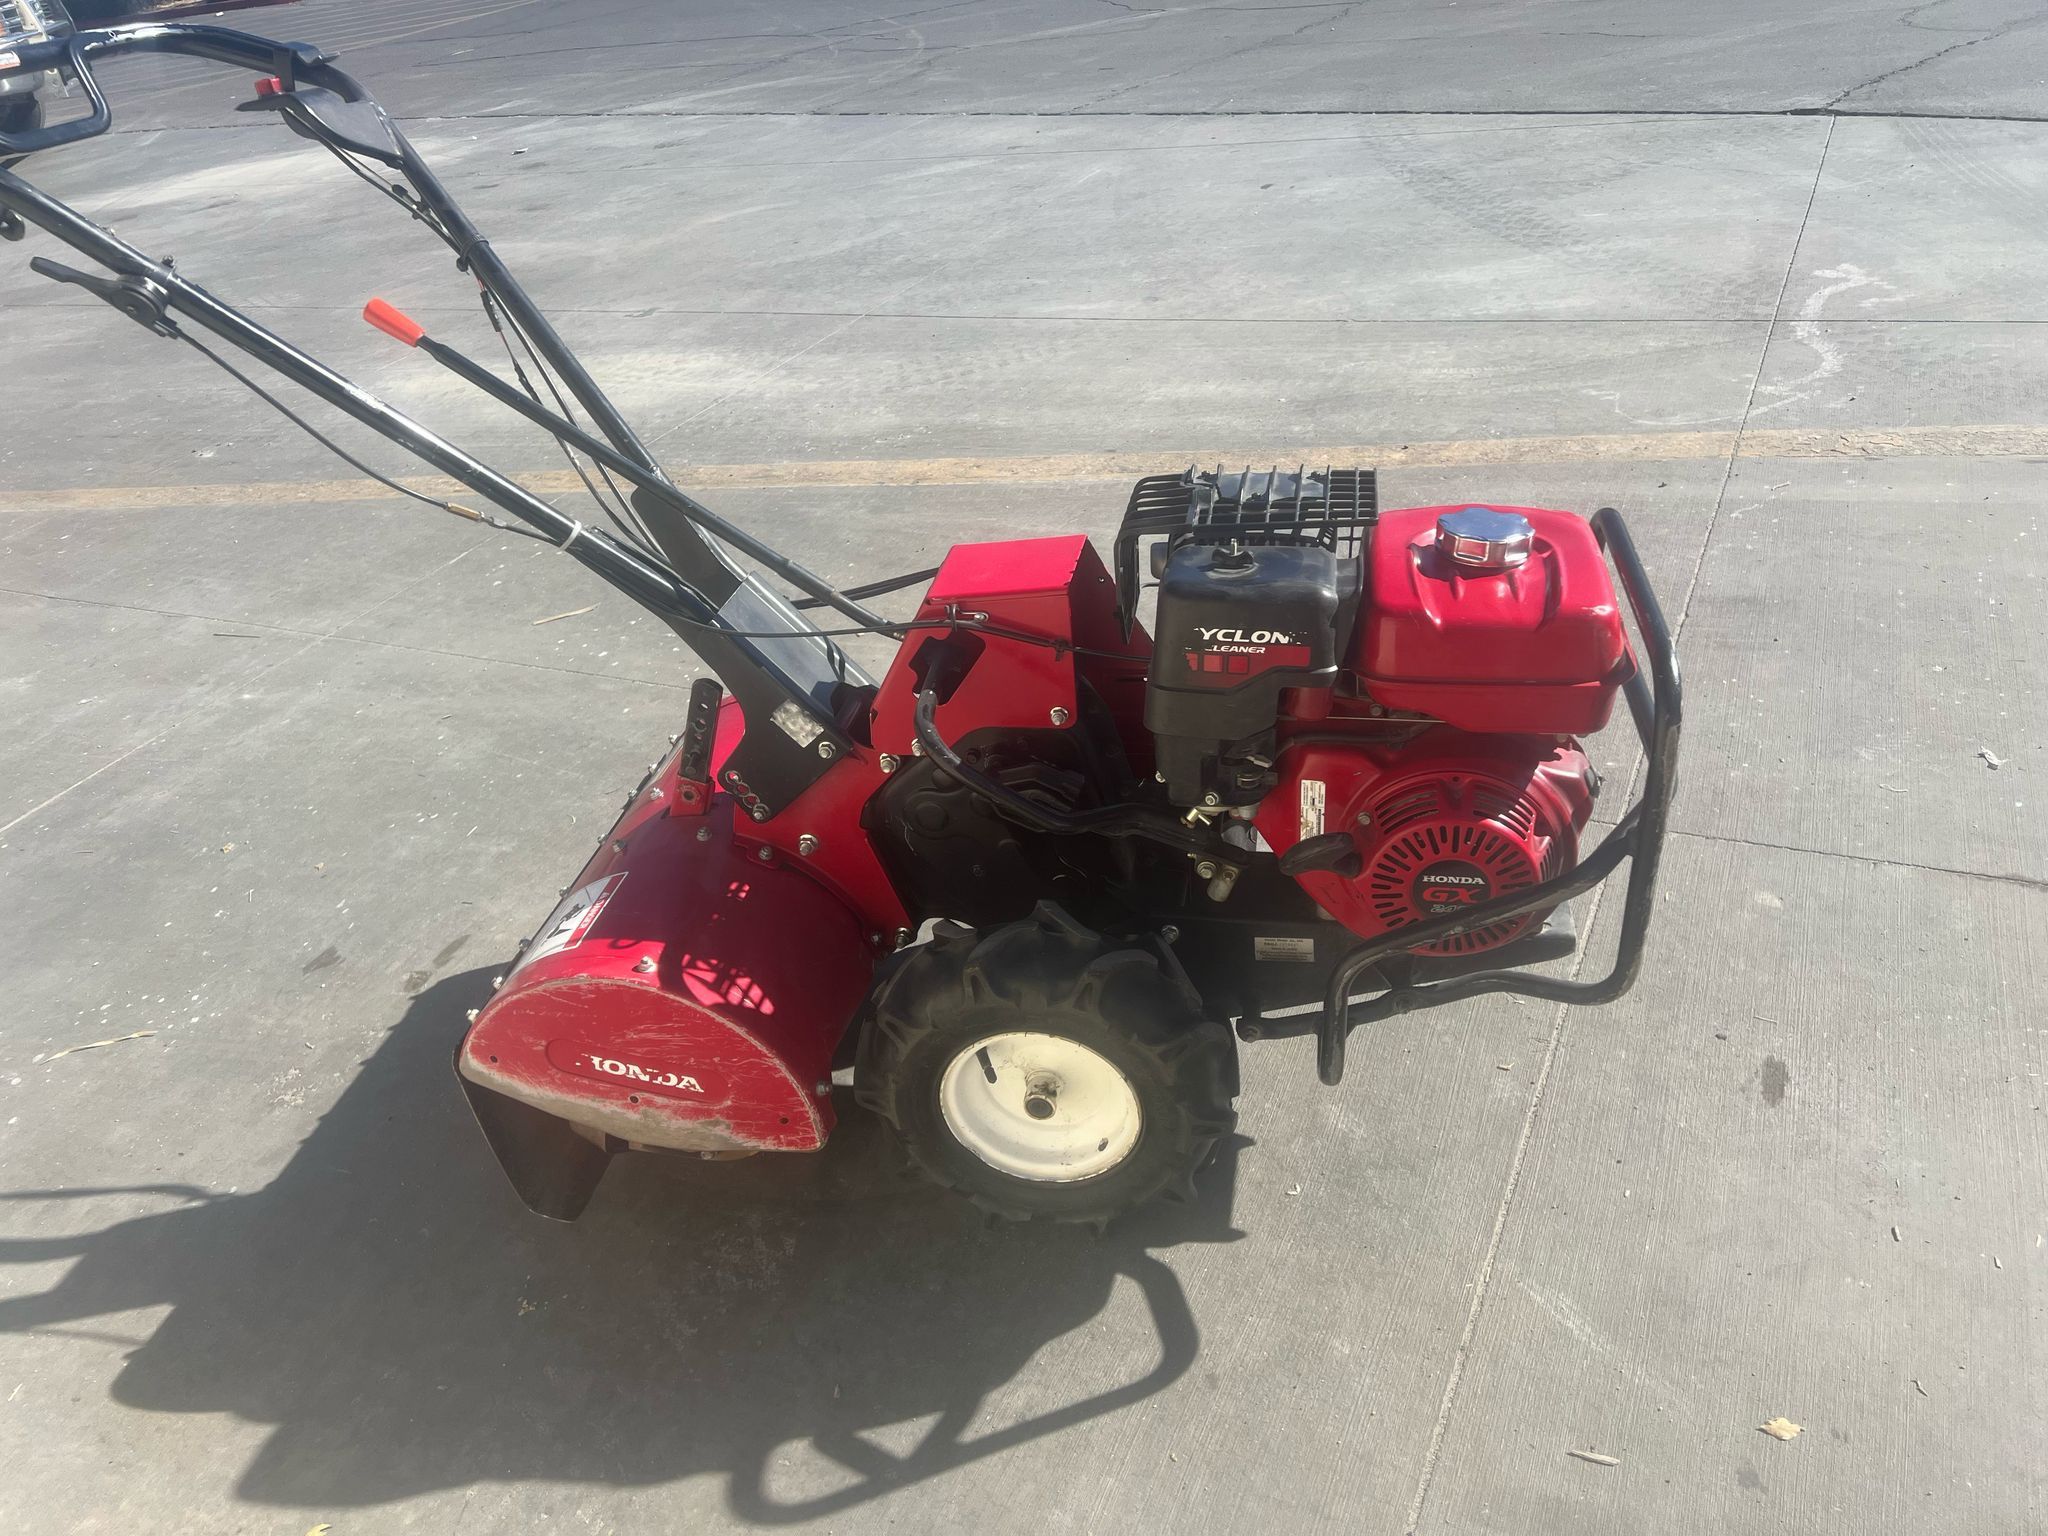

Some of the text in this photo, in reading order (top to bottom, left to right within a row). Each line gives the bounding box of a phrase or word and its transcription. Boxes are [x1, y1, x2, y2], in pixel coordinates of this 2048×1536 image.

[1195, 627, 1302, 645] YCLON
[1206, 645, 1265, 653] LEANER
[1423, 876, 1485, 885] HONDA
[1423, 888, 1481, 903] GX
